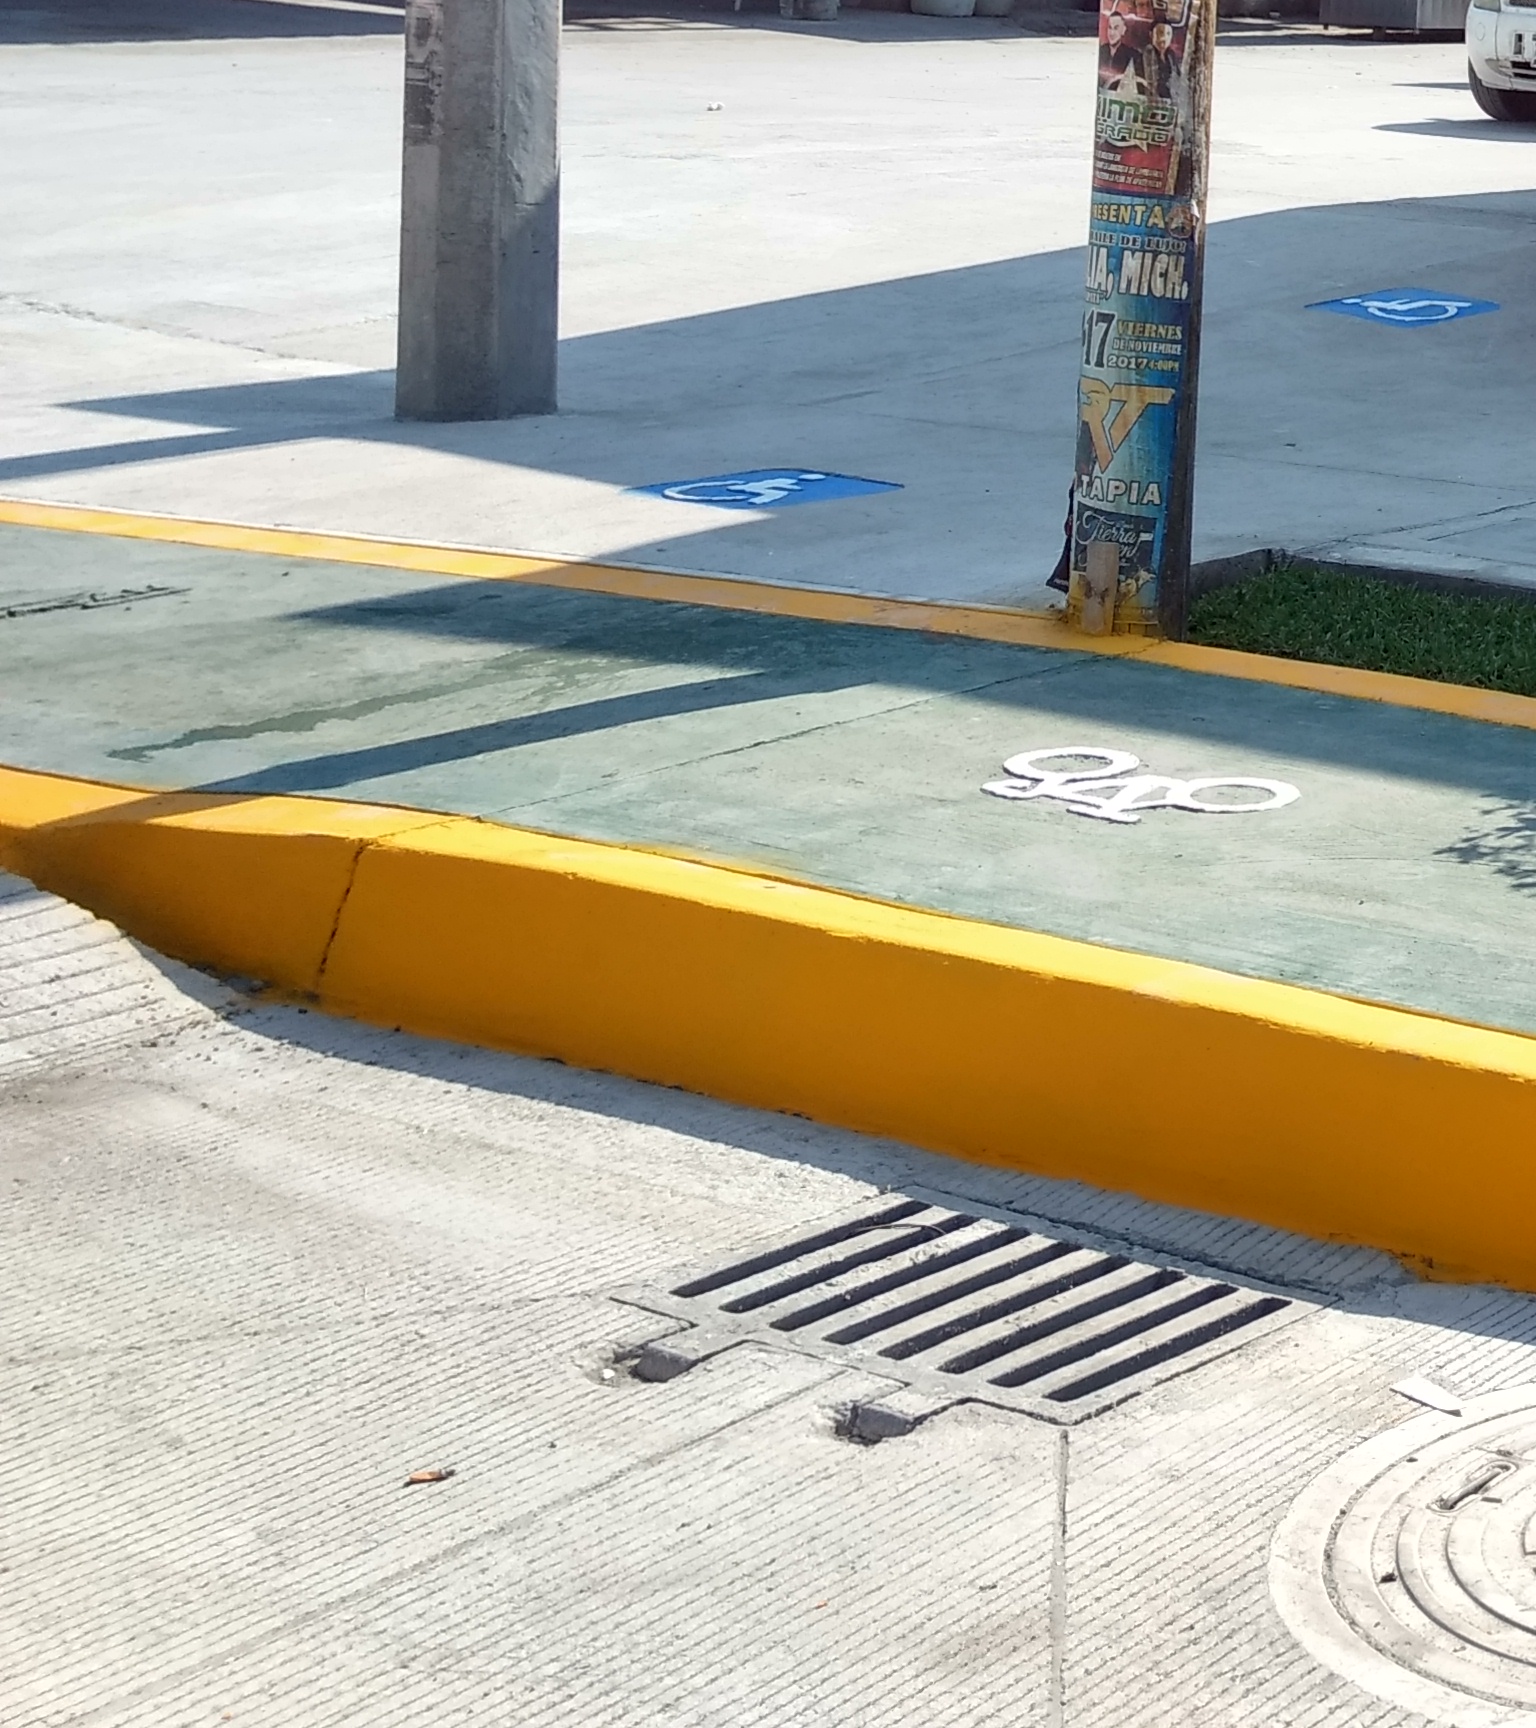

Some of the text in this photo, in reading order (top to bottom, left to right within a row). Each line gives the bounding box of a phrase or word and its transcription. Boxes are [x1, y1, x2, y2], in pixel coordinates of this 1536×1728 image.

[1119, 234, 1141, 249] DE
[1118, 249, 1189, 301] MICH.
[1117, 320, 1183, 340] VIERNES
[1112, 338, 1182, 355] DE NOVIEMBRE
[1107, 354, 1148, 370] 2017
[1080, 474, 1162, 505] TAPIA
